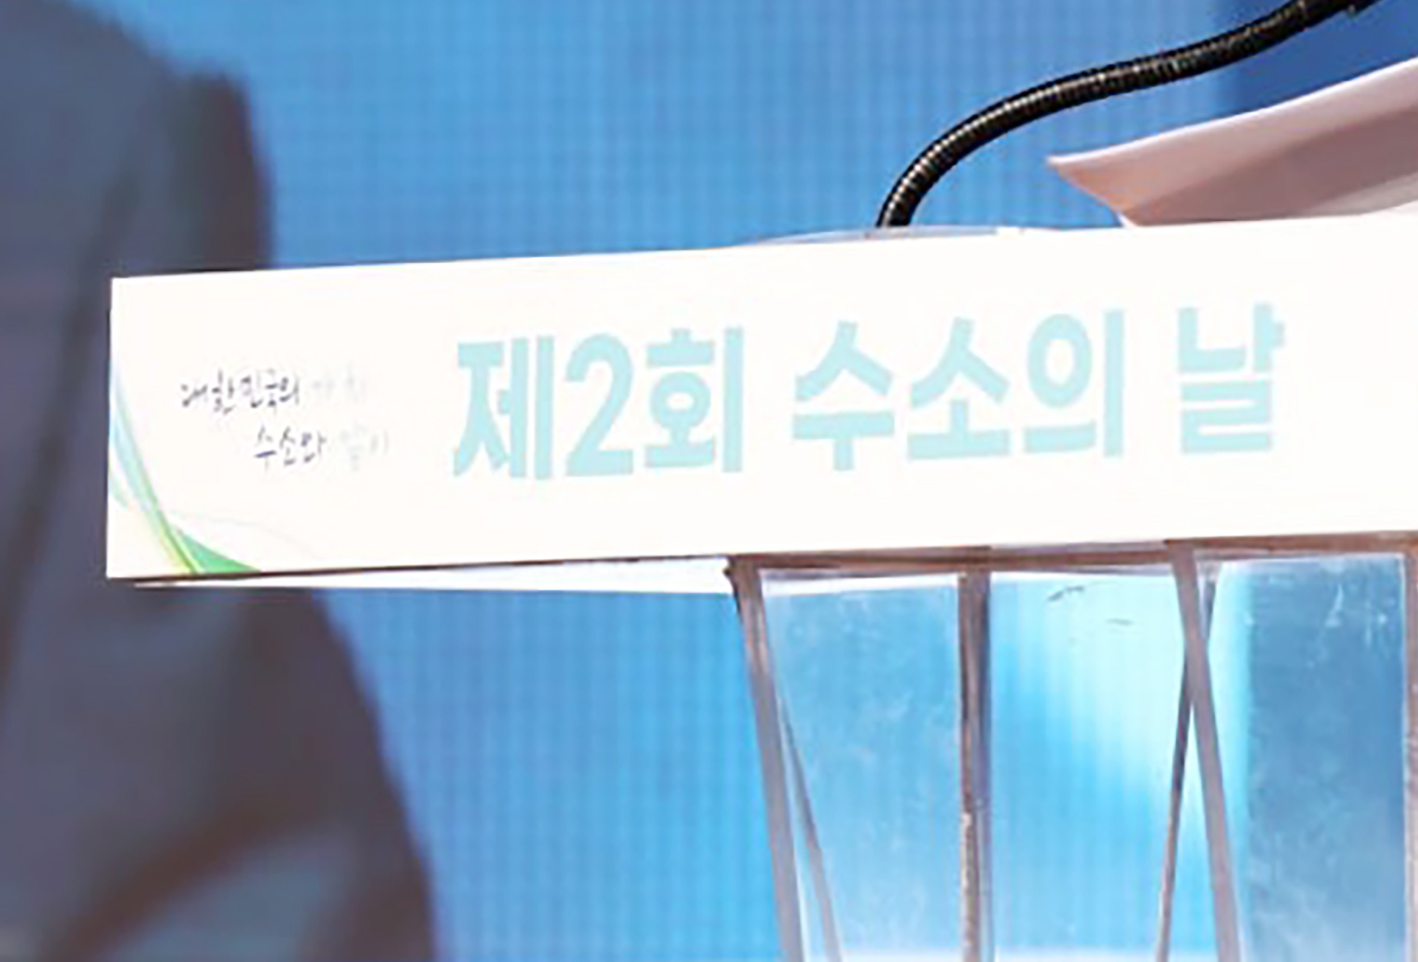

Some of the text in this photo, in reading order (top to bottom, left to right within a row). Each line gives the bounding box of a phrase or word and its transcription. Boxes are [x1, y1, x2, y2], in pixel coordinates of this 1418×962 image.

[453, 303, 1286, 481] 제2회 수소의 날
